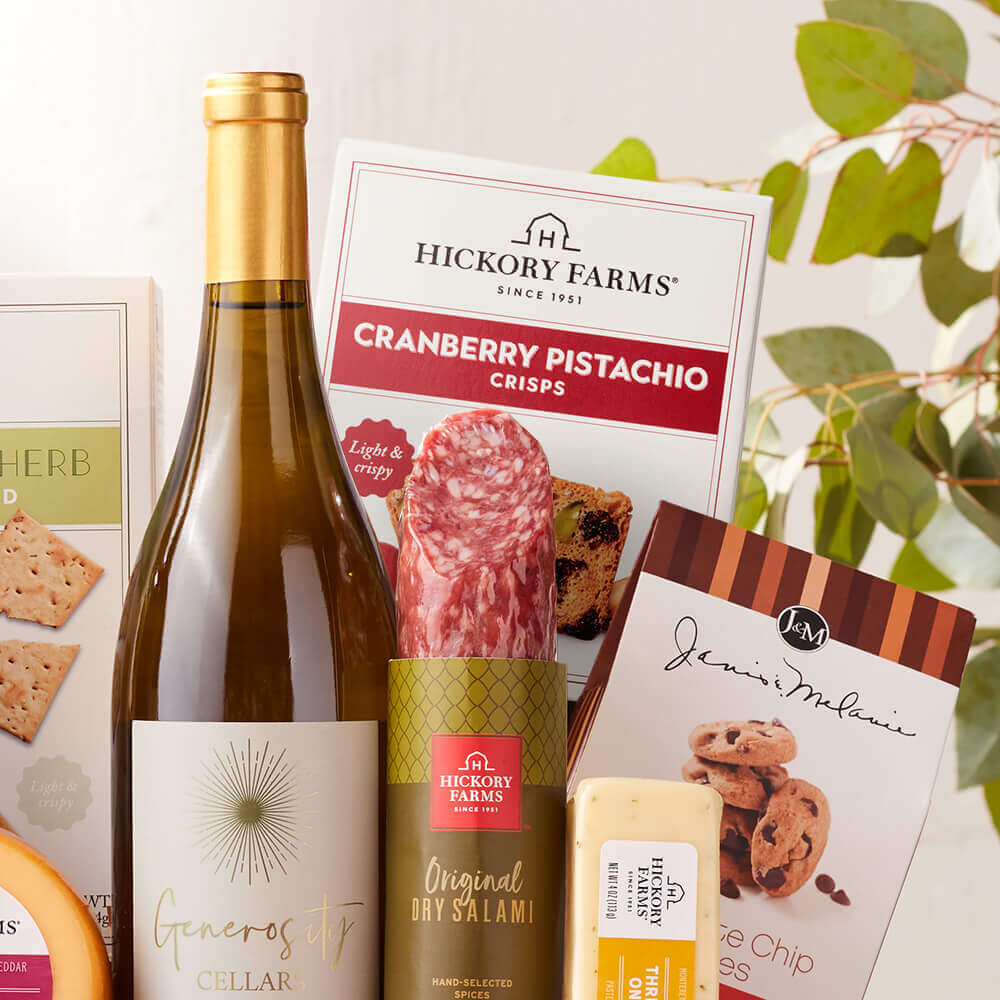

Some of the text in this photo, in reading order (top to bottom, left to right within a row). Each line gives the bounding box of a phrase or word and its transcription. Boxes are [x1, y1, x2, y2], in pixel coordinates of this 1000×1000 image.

[539, 229, 555, 248] H
[415, 242, 560, 282] HICKORY
[497, 285, 583, 305] SINCE 1951
[353, 322, 709, 391] CRANBERRY PISTACHIO
[489, 372, 565, 397] CRISPS
[348, 439, 404, 460] Light &
[353, 462, 394, 481] crispy
[780, 609, 826, 646] J&M
[472, 760, 482, 770] H
[439, 775, 513, 788] HICKORY
[449, 790, 504, 803] FARMS
[424, 855, 523, 907] Original
[650, 857, 663, 927] HICKORY
[411, 897, 534, 924] DRY SALAMI
[154, 887, 365, 972] Generosity
[751, 933, 815, 977] Chip
[196, 969, 306, 992] CELLARS
[432, 977, 513, 988] HAND-SELECTED
[454, 991, 490, 1000] SPICES
